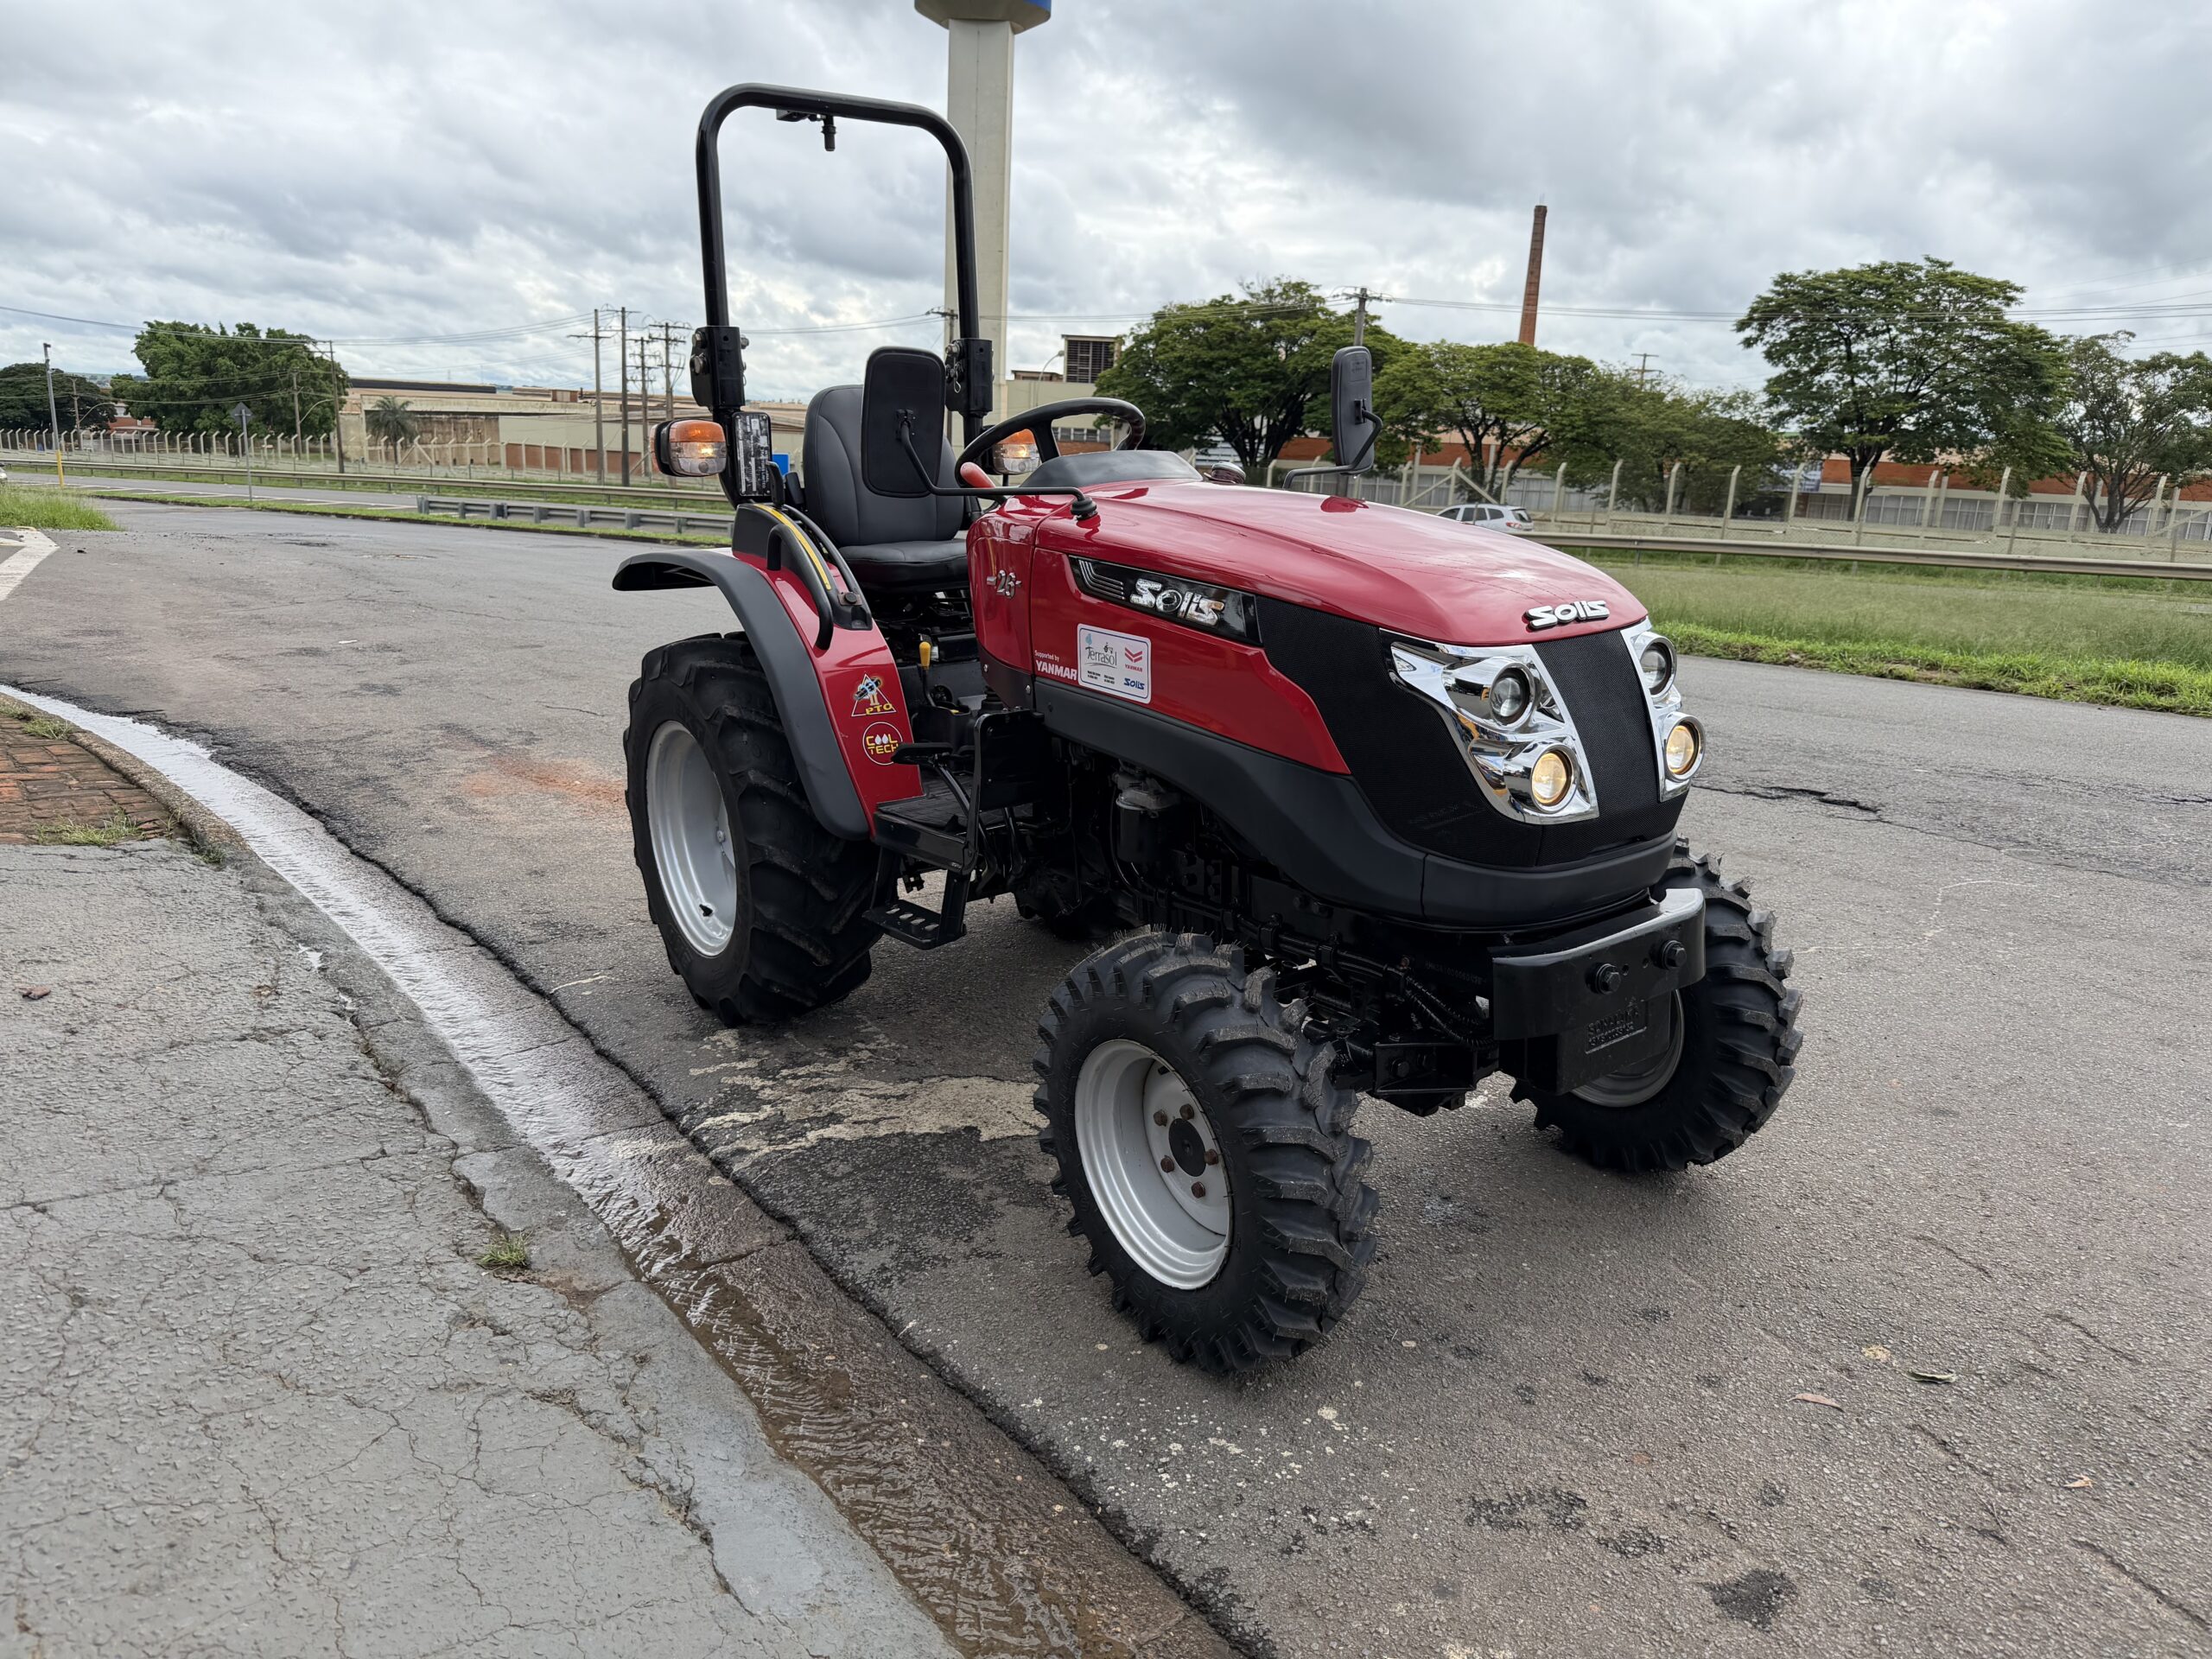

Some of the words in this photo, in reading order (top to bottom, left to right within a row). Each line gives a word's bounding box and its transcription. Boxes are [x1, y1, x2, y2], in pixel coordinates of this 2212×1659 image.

[1034, 650, 1052, 659] Supported
[1053, 654, 1060, 663] by
[1084, 646, 1117, 666] Terrasol
[1036, 659, 1077, 681] YANMAR
[1124, 664, 1143, 673] YANMAR
[866, 703, 893, 715] PTO
[867, 743, 899, 755] TECH
